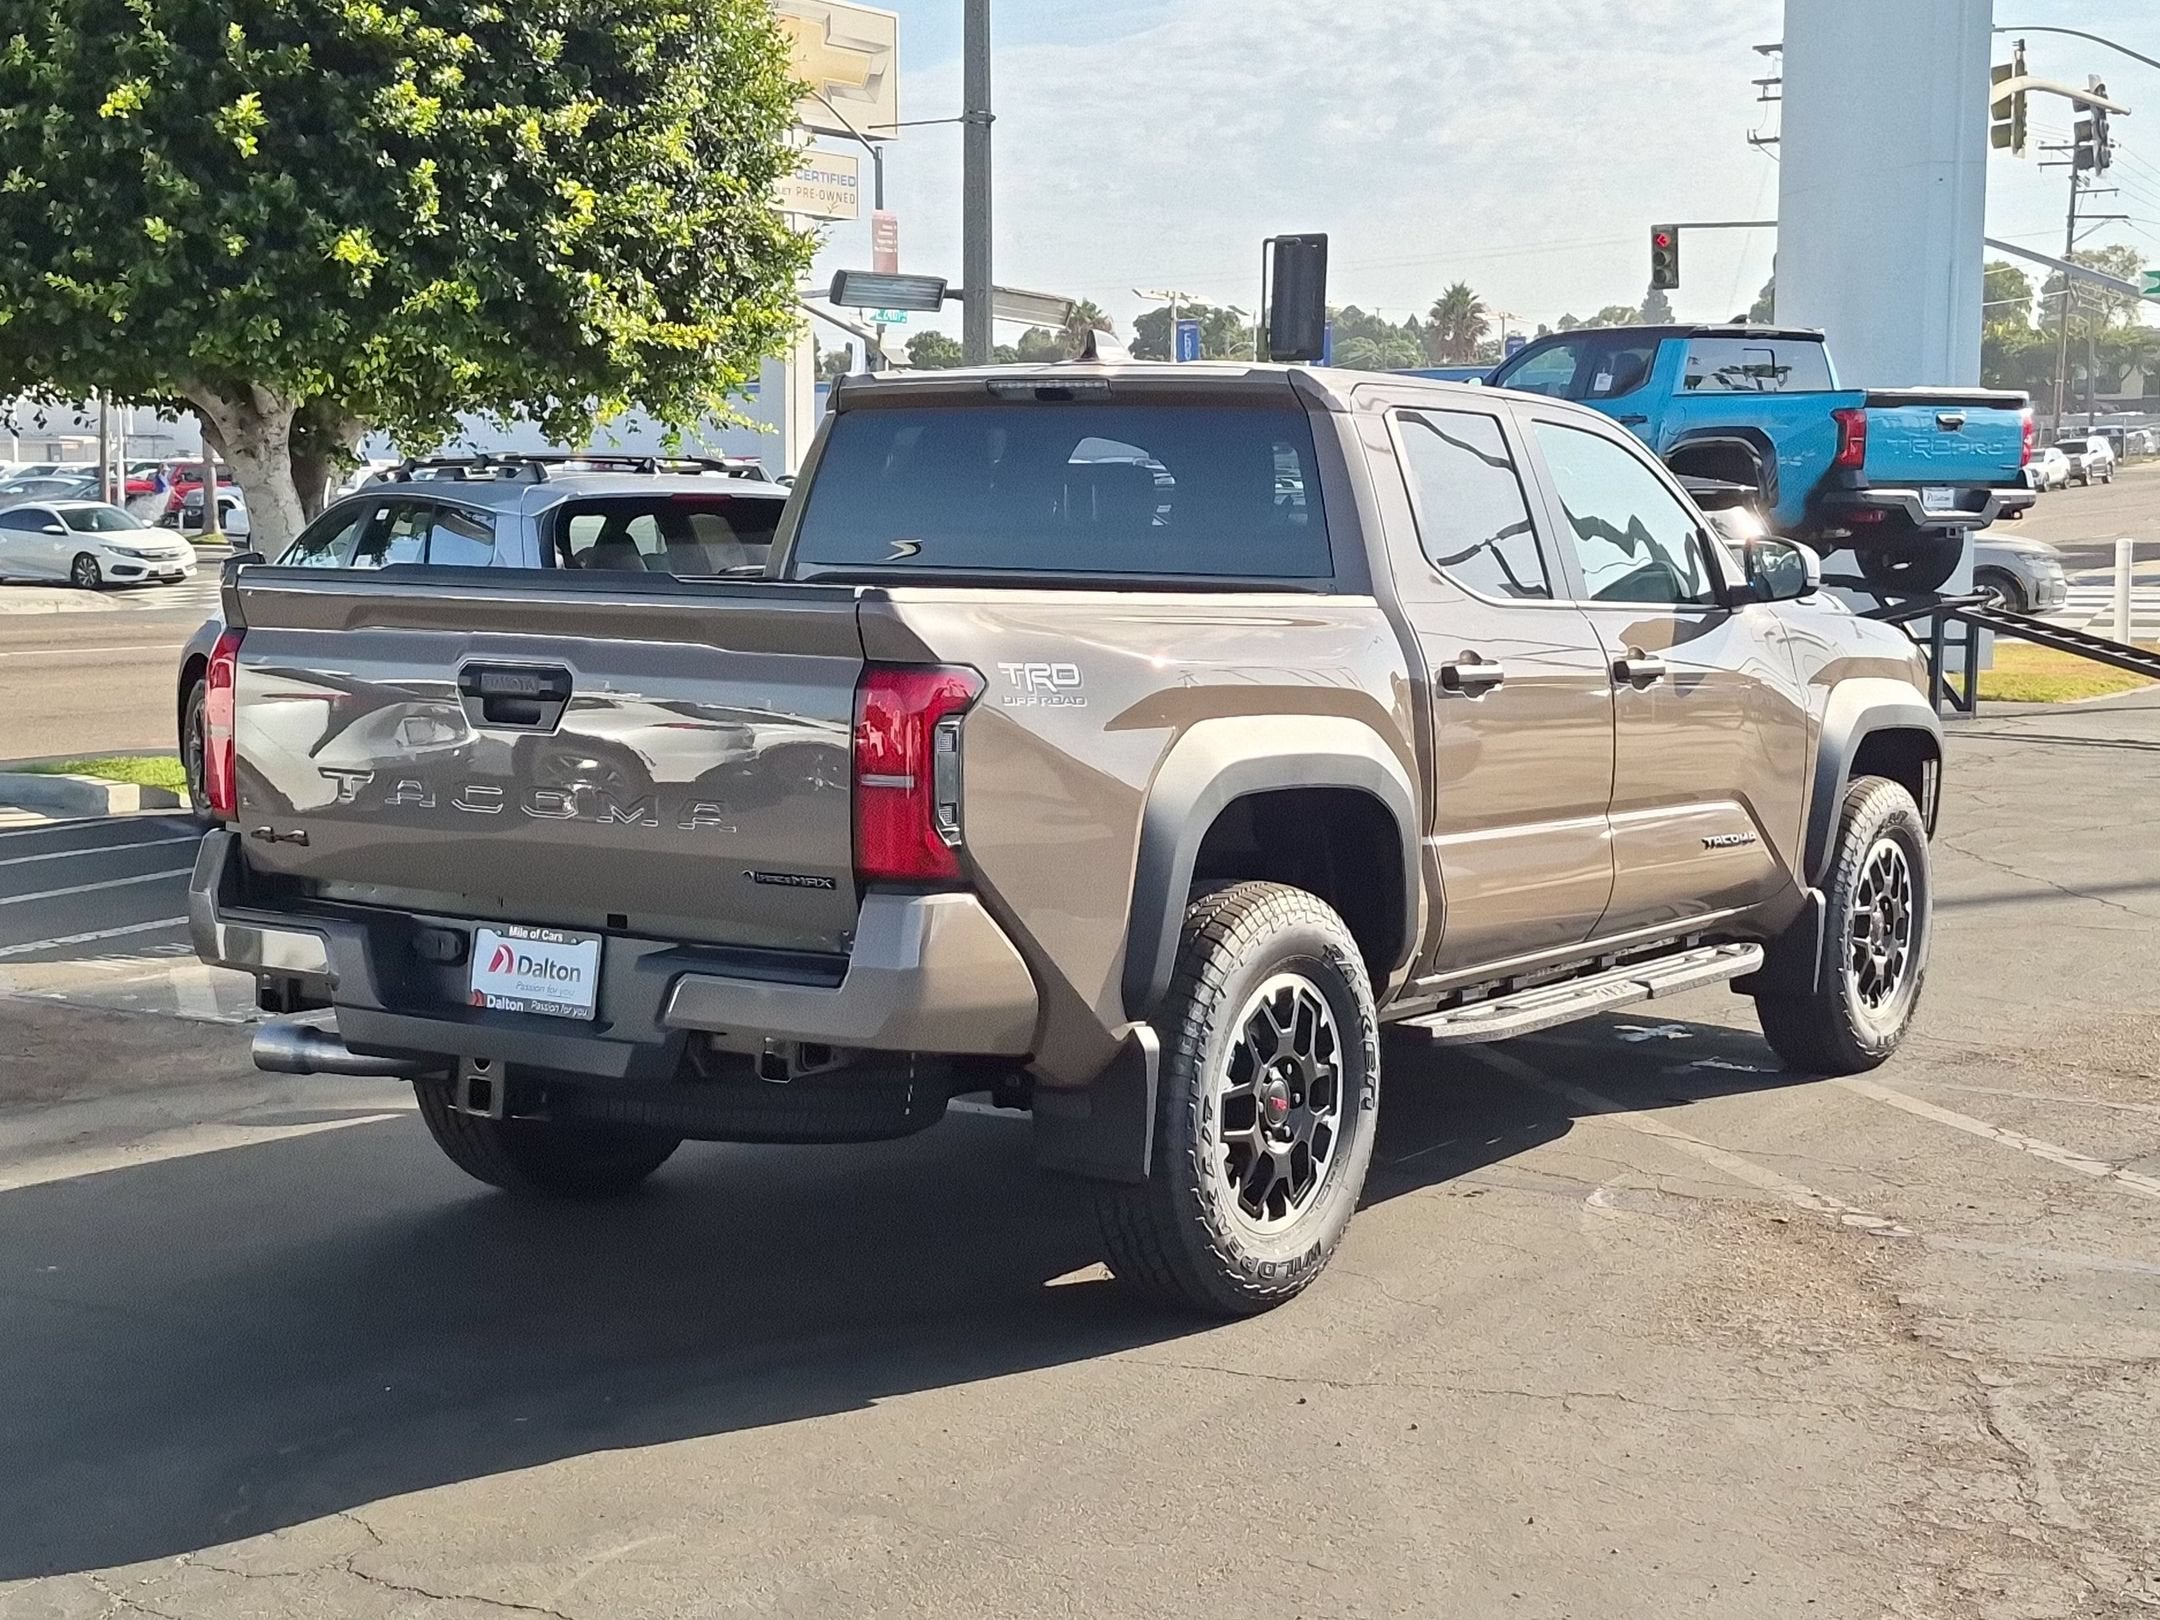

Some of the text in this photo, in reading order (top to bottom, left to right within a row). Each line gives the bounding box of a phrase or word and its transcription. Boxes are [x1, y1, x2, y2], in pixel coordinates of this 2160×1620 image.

[795, 169, 856, 187] CERTIFIED
[796, 186, 856, 204] PRE-OWNED
[997, 662, 1082, 692] TRD
[1002, 694, 1087, 707] OFF ROAD
[318, 767, 738, 833] TACOMA
[1702, 831, 1757, 849] TACOMA
[509, 926, 563, 942] Mile of Cars
[517, 955, 581, 982] Dalton
[516, 981, 545, 993] Passion
[546, 984, 558, 995] for
[487, 995, 588, 1017] Dalton Passion for you
[1322, 943, 1376, 1110] FALKEN
[1201, 1094, 1322, 1279] WILDPEAK A/T
